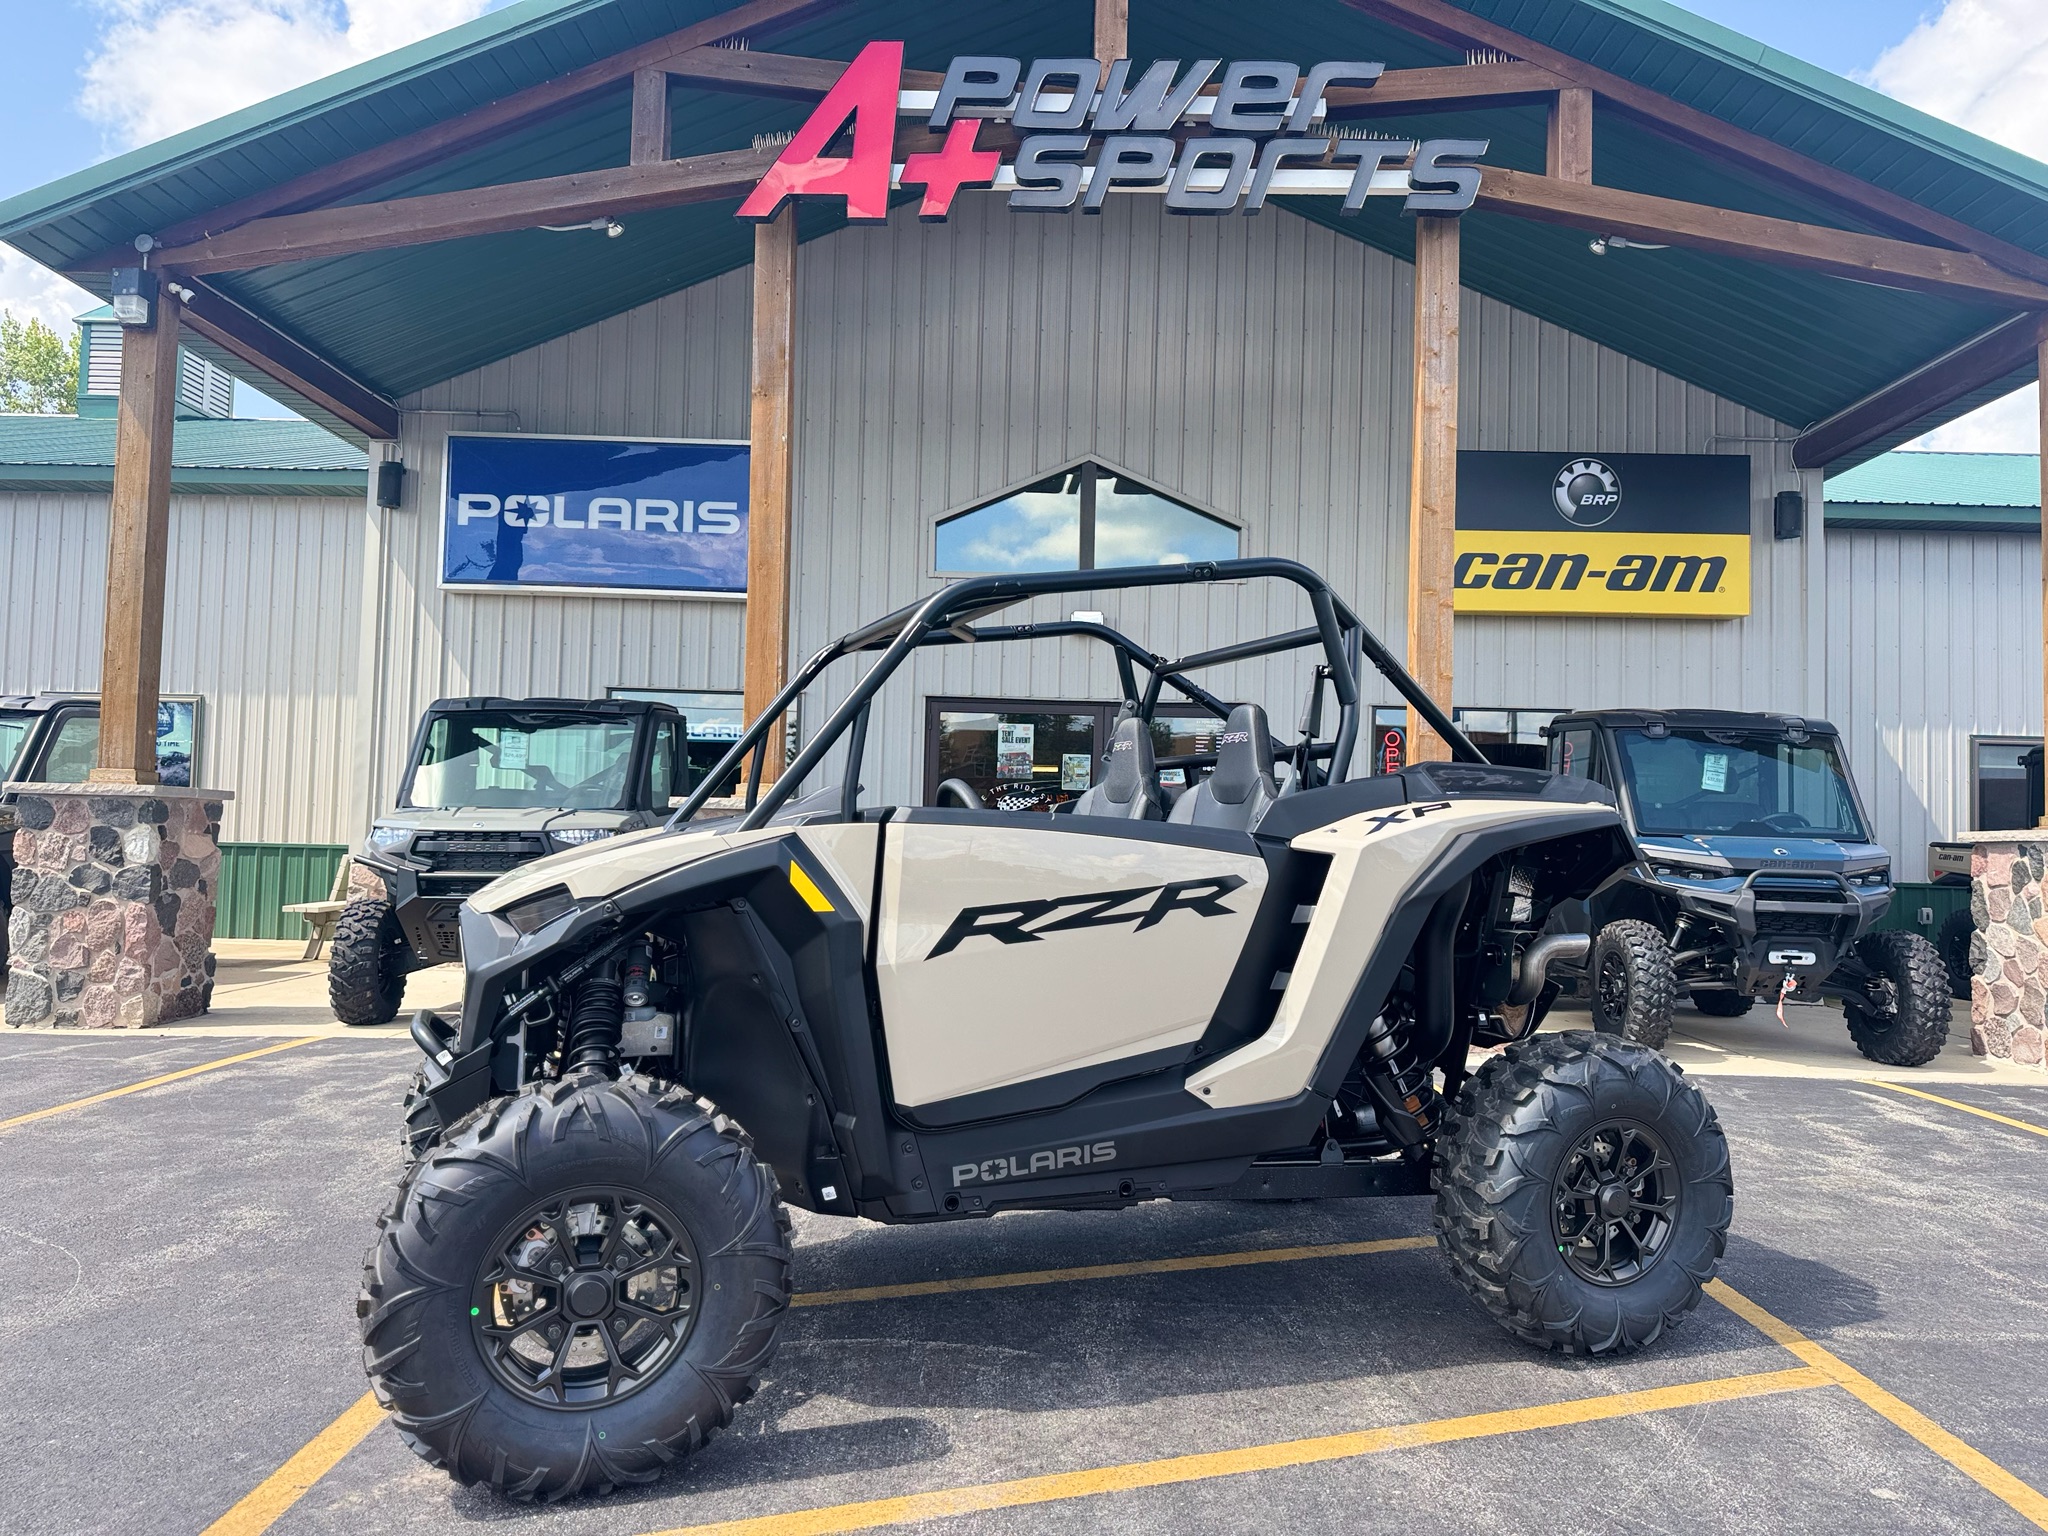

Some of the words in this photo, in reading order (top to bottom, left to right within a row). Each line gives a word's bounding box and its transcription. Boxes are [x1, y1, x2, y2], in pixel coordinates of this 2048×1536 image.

[735, 41, 1001, 222] A+
[1580, 494, 1618, 506] BRP
[457, 493, 741, 535] POLARIS
[1454, 552, 1728, 593] can-am
[1221, 732, 1248, 745] RZR
[1384, 731, 1400, 774] OPE
[989, 784, 1008, 795] THE
[1013, 783, 1036, 794] RIDE
[628, 819, 644, 830] XP
[1364, 801, 1452, 836] XP
[447, 842, 506, 852] POLARIS
[1939, 853, 1964, 862] can-am
[1759, 858, 1816, 869] can-am
[922, 874, 1249, 962] RZR
[952, 1140, 1117, 1187] POLARIS
